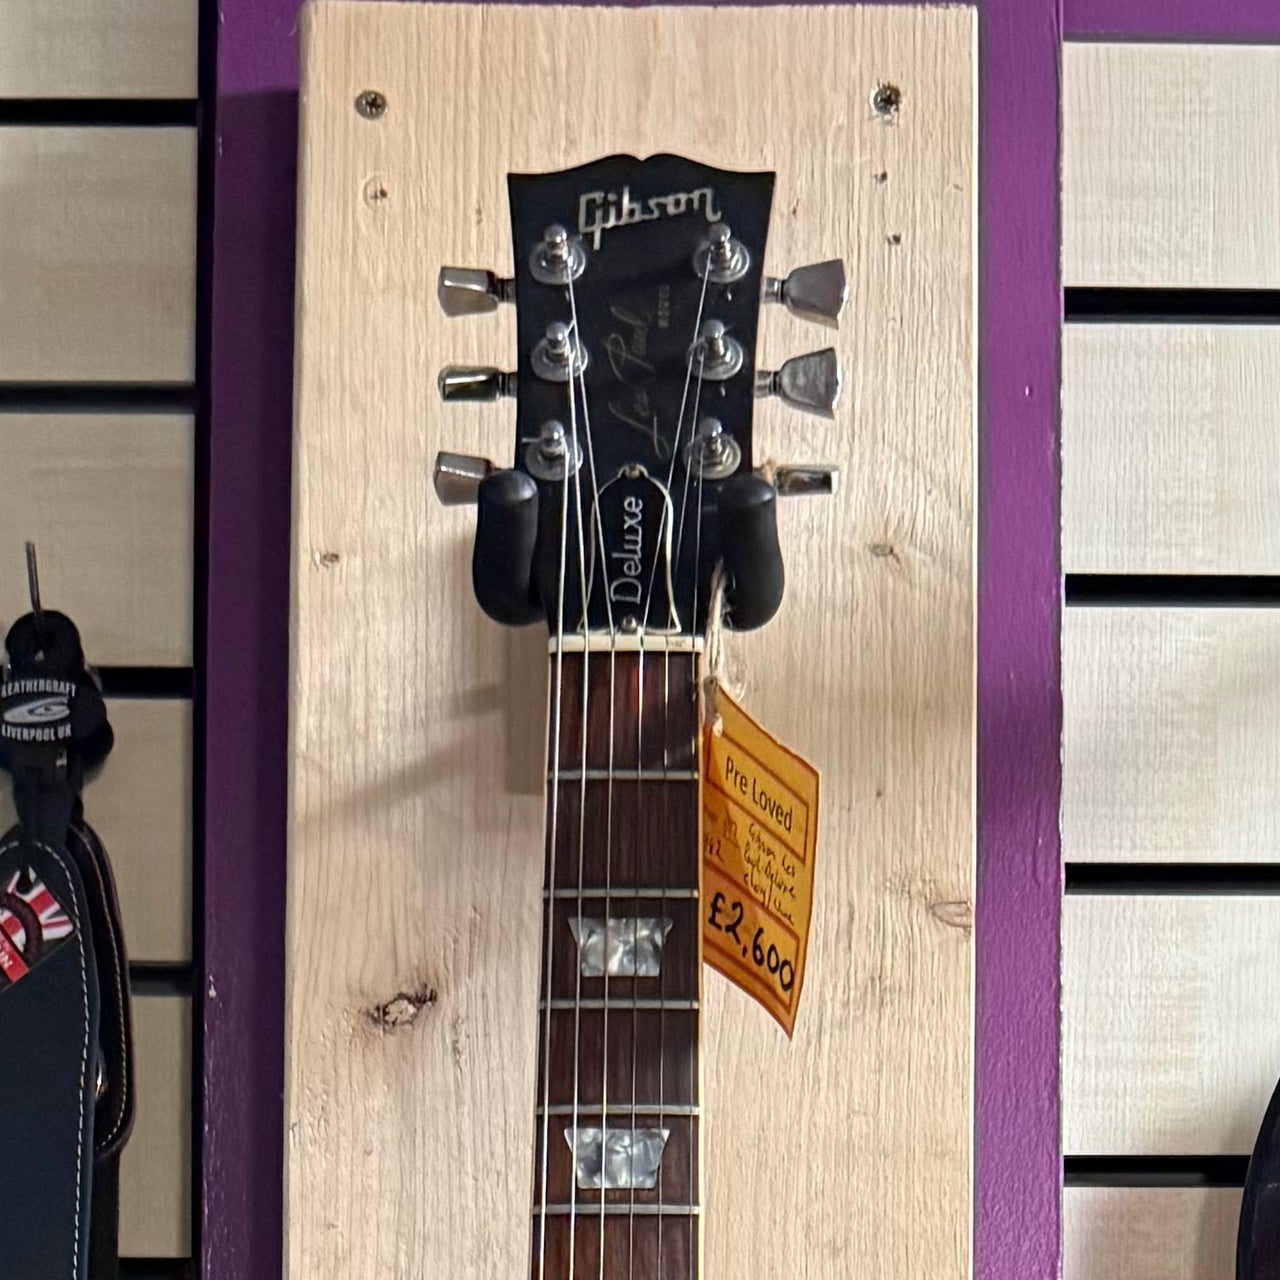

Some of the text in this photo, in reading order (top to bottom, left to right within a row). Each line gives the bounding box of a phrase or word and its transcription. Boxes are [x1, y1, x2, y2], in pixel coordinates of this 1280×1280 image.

[578, 186, 721, 250] Gibson
[610, 496, 644, 604] Deluxe
[1, 679, 75, 698] LEATHERCRAFT
[1, 724, 71, 742] LIVERPOOL UK
[726, 755, 747, 795] Pre
[752, 777, 793, 834] Loved
[708, 891, 795, 992] £2,600
